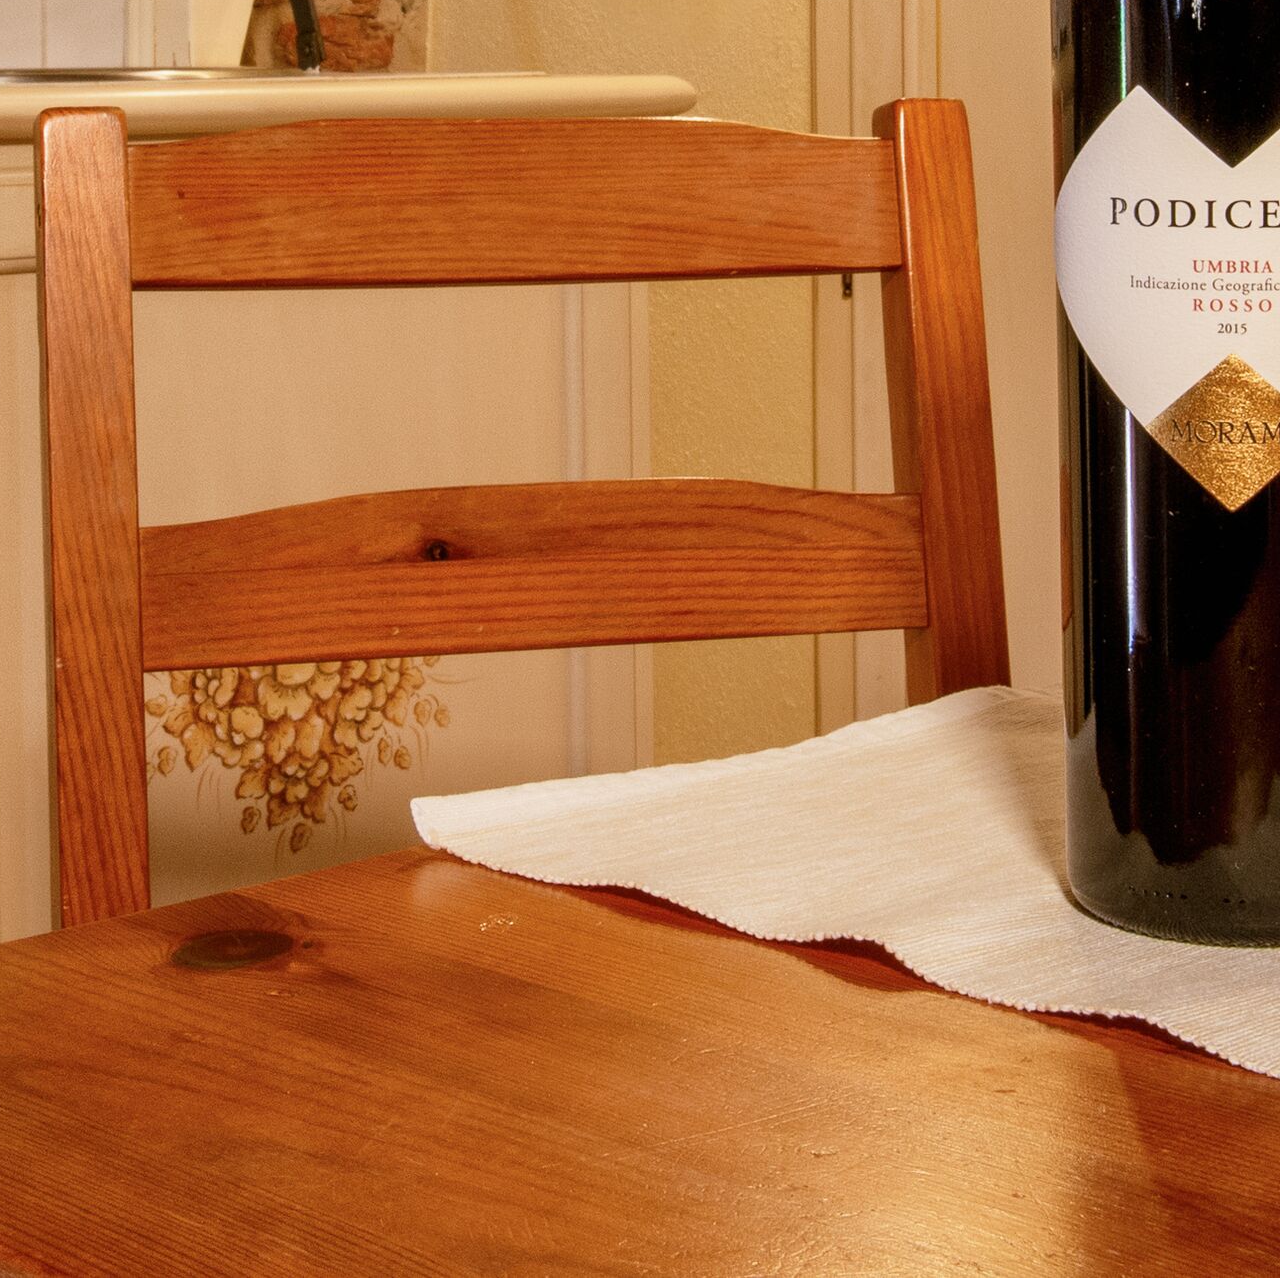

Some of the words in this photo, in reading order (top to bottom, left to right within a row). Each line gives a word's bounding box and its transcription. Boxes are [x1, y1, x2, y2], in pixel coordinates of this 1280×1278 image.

[1192, 260, 1273, 274] UMBRIA
[1130, 275, 1207, 291] Indicazione
[1192, 298, 1273, 312] ROSSO
[1217, 323, 1248, 334] 2015
